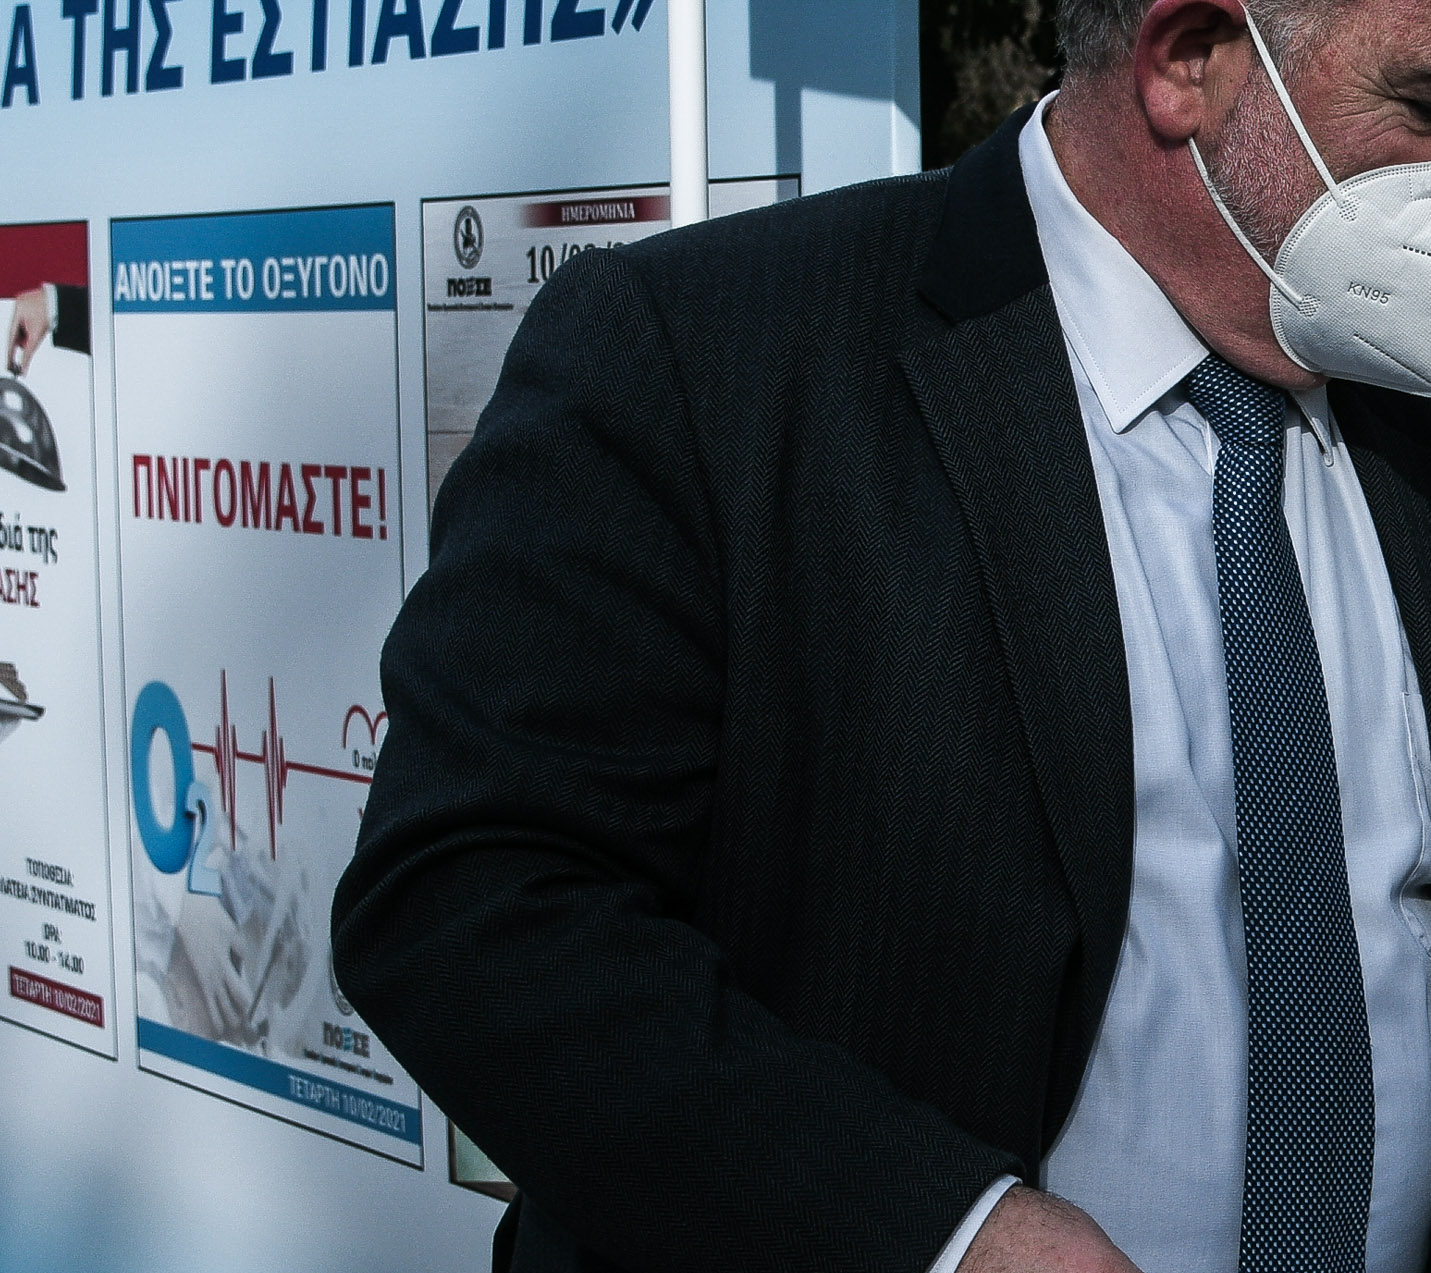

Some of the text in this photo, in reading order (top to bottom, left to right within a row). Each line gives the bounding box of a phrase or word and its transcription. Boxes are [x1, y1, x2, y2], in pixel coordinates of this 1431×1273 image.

[561, 203, 636, 222] ΗΜΕΡΟΜΗΝΙΑ
[114, 253, 390, 301] ΑΝΟΙΞΤΕ ΤΟ ΟΞΥΓΟΝΟ
[1348, 281, 1390, 304] KN95
[132, 453, 388, 540] ΠΝΙΓΟΜΑΣΤΕ!
[26, 526, 58, 564] της
